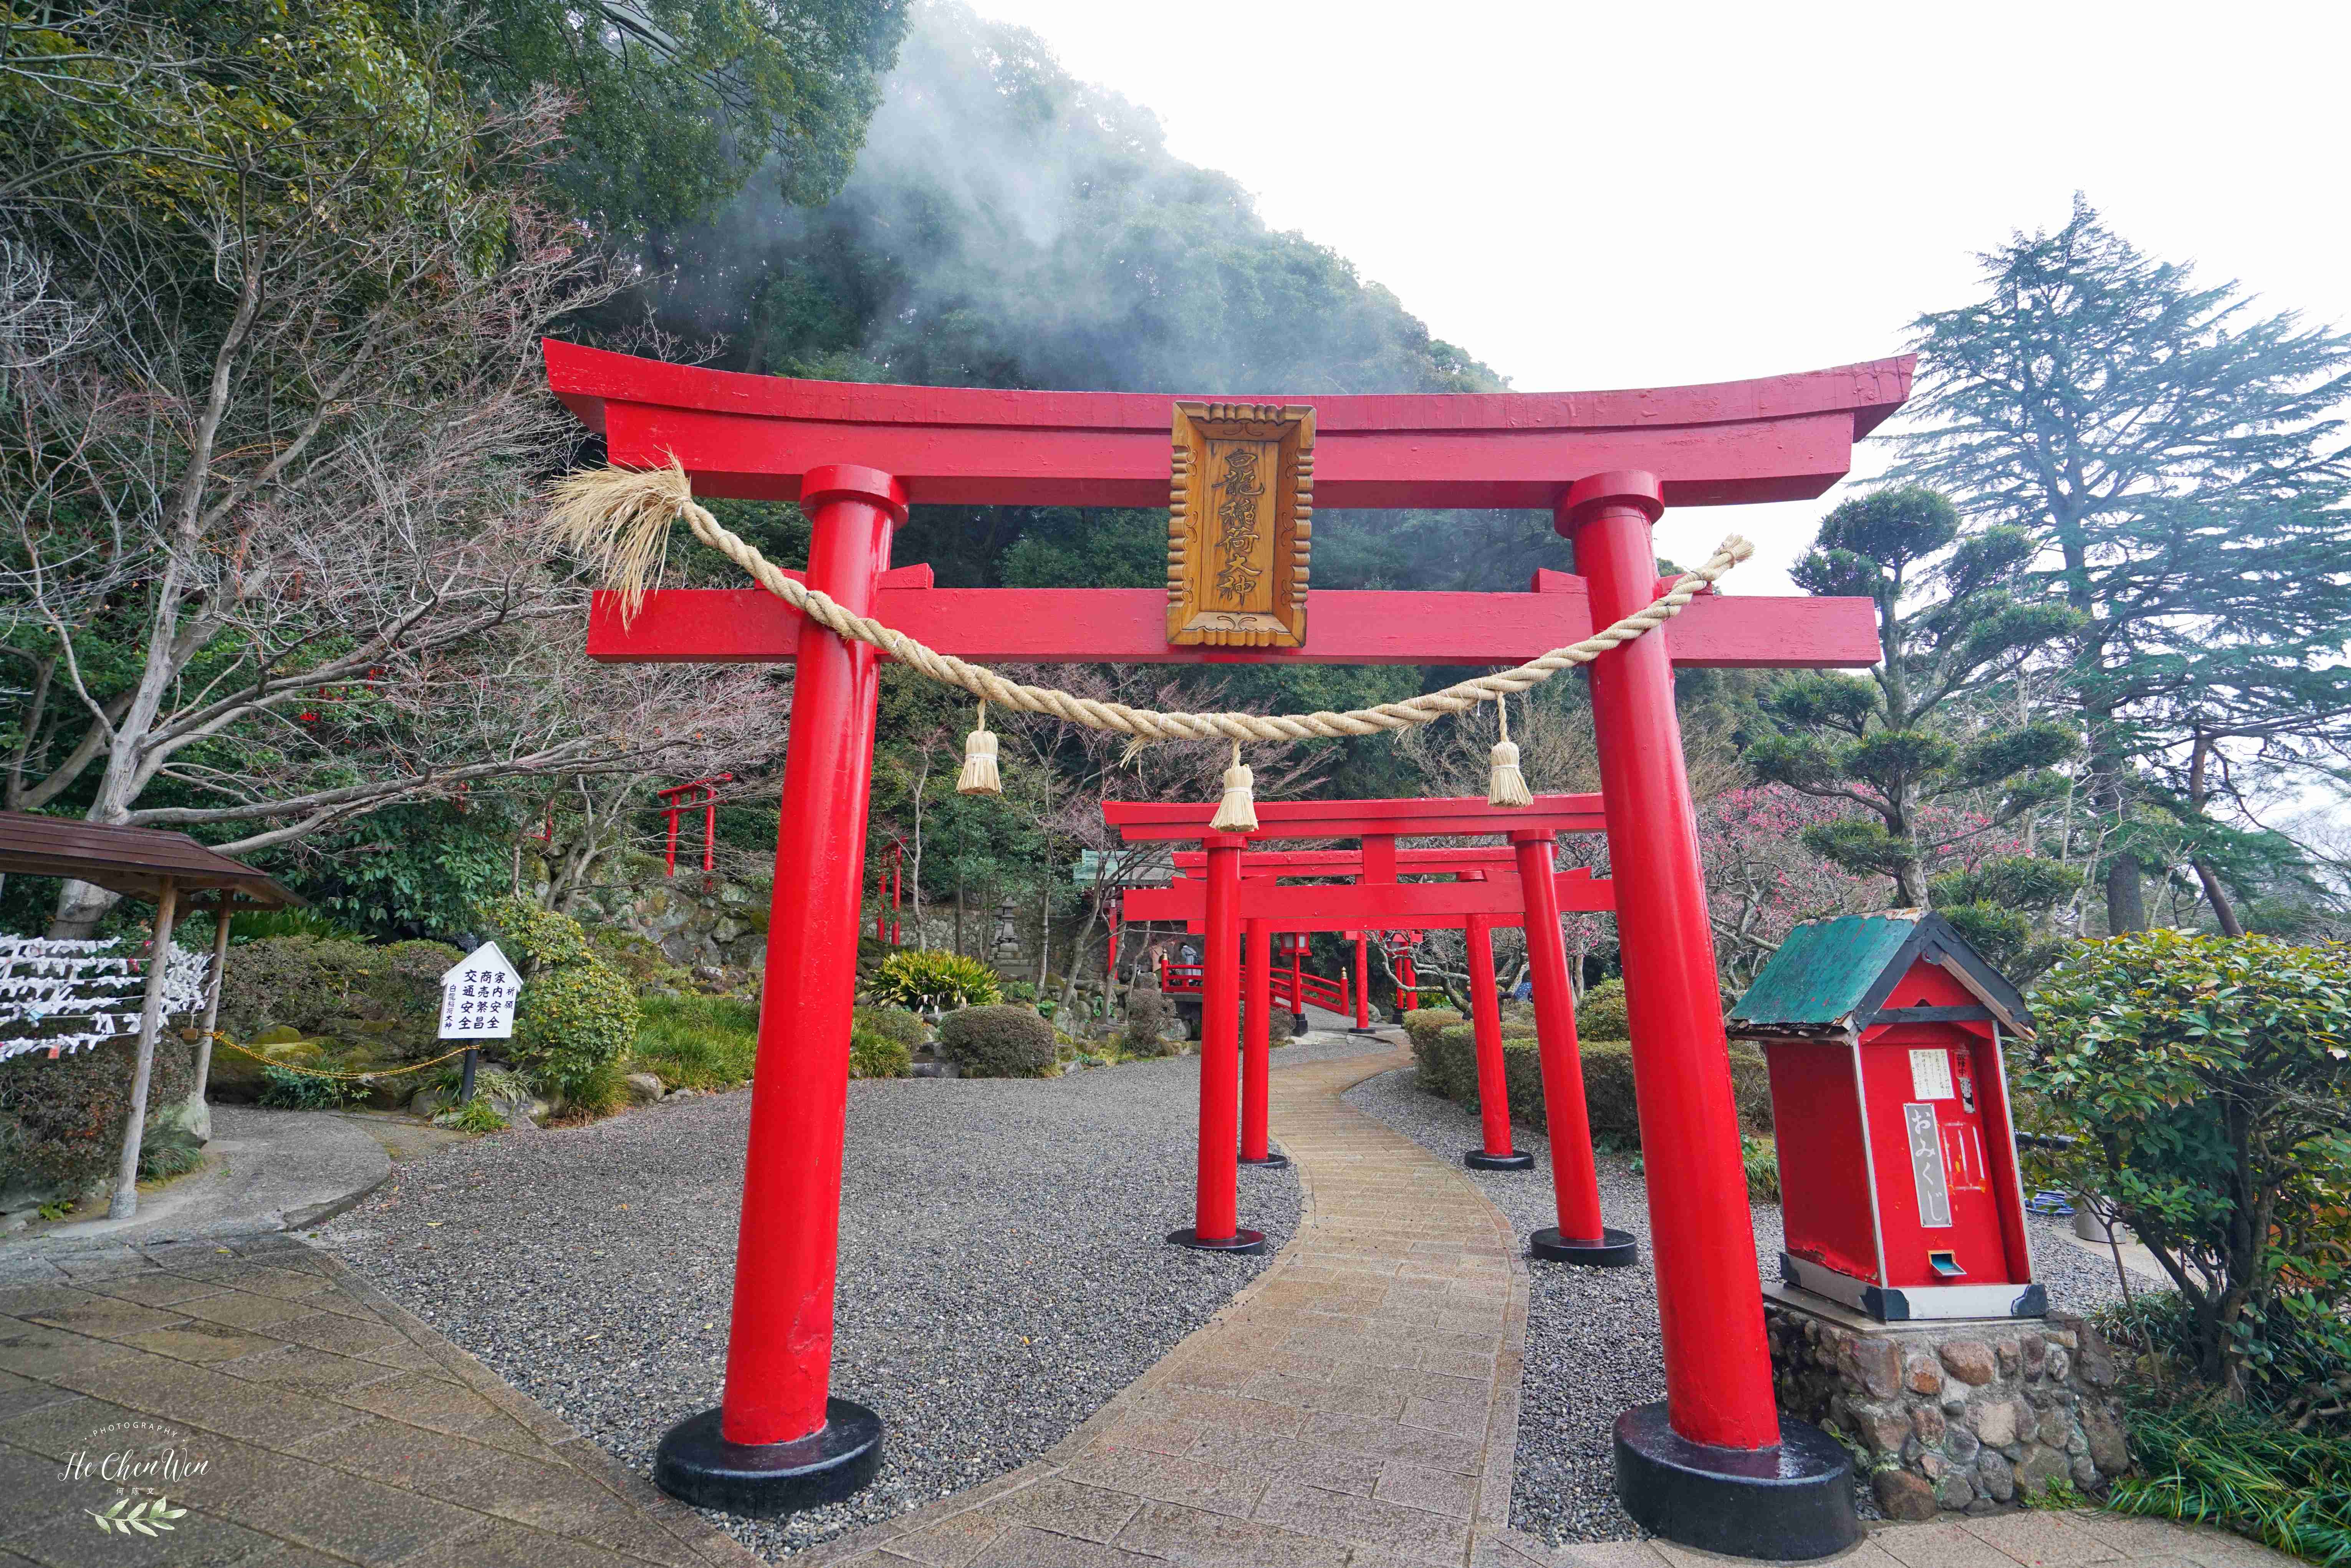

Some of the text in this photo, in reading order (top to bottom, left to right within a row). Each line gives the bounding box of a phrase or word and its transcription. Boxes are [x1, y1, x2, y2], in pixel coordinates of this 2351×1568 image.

[1212, 448, 1265, 606] 白龍稲荷大神
[444, 984, 456, 1030] 白龍稲荷大神
[458, 969, 477, 1030] 交通安全
[474, 970, 492, 1029] 商売繁昌
[487, 972, 506, 1029] 家内安全
[504, 987, 515, 1009] 祈願
[1912, 1109, 1942, 1221] おみくじ
